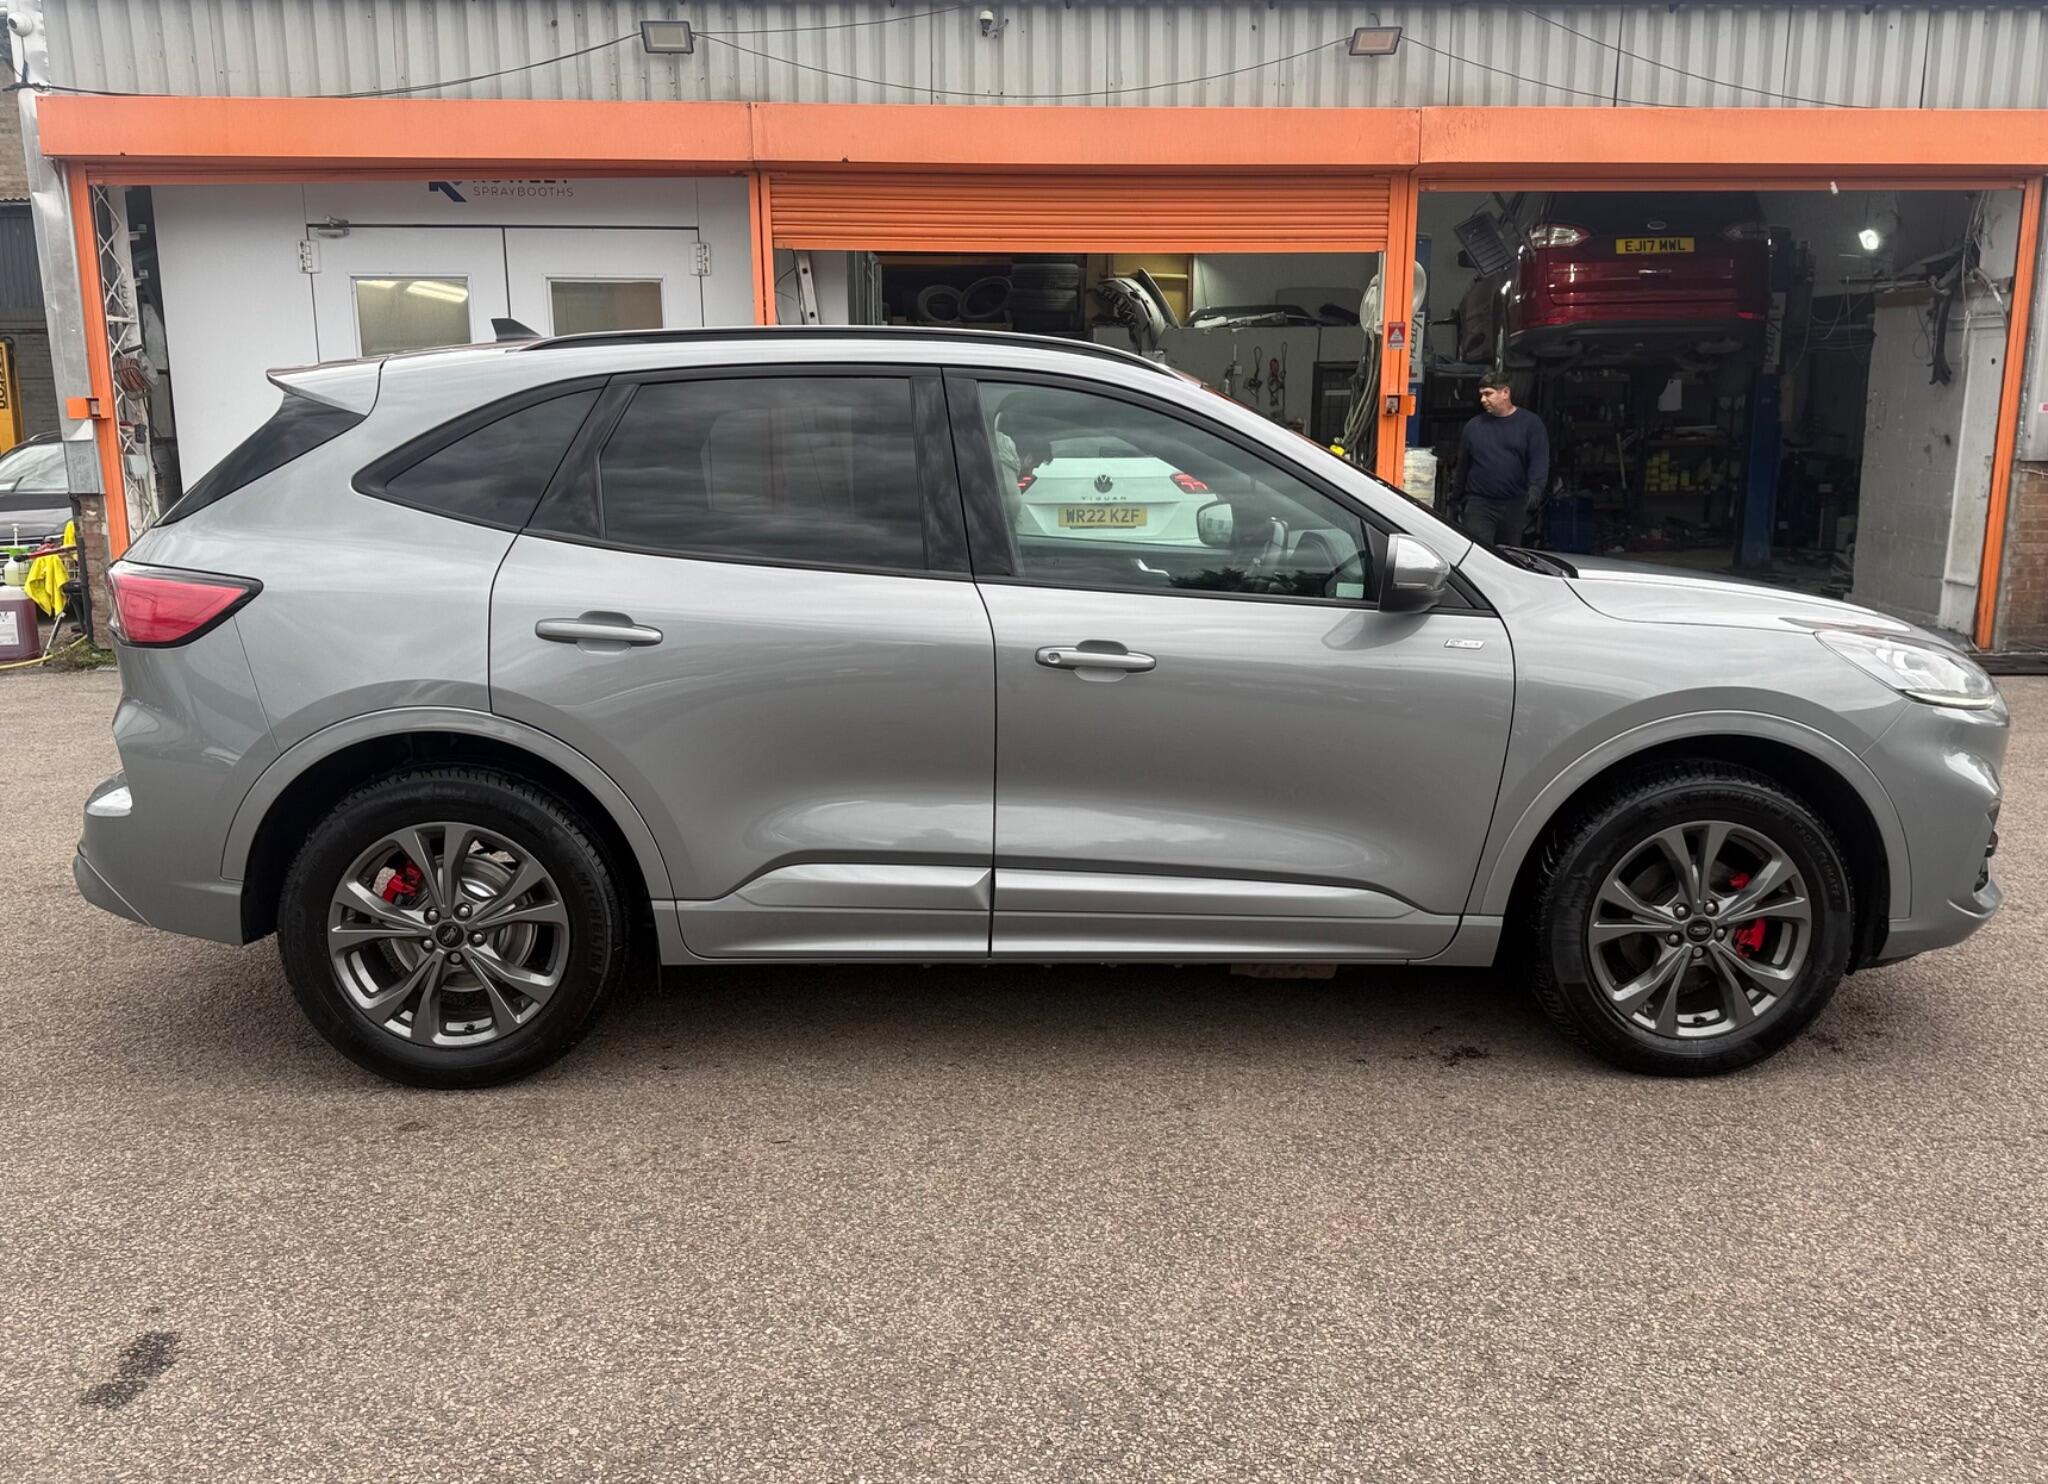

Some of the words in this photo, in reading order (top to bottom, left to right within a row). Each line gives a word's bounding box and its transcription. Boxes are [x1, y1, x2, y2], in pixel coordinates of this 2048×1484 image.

[473, 186, 574, 197] SPRAYBOOTHS
[1624, 239, 1655, 252] EJ17
[1659, 239, 1686, 251] MWL
[1066, 508, 1106, 523] WR22
[1110, 508, 1141, 523] KZF
